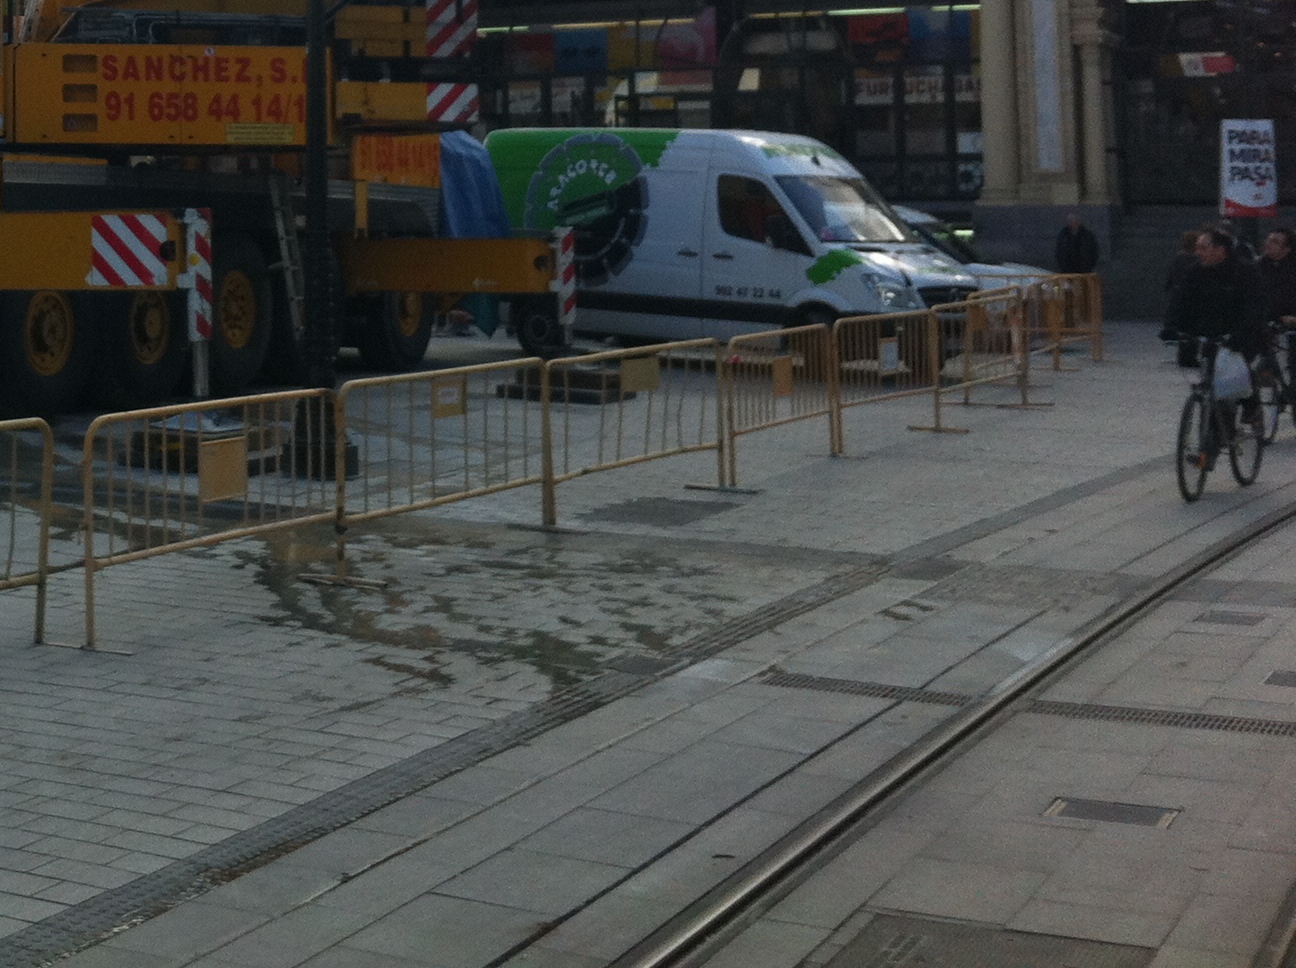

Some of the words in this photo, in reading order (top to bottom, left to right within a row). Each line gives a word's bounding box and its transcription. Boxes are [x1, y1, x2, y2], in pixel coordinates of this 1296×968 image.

[102, 54, 264, 88] SANCHEZ,
[105, 91, 136, 121] 91
[148, 92, 198, 122] 658
[208, 93, 241, 122] 44
[1229, 148, 1273, 163] MIRA
[1229, 165, 1274, 182] PASA
